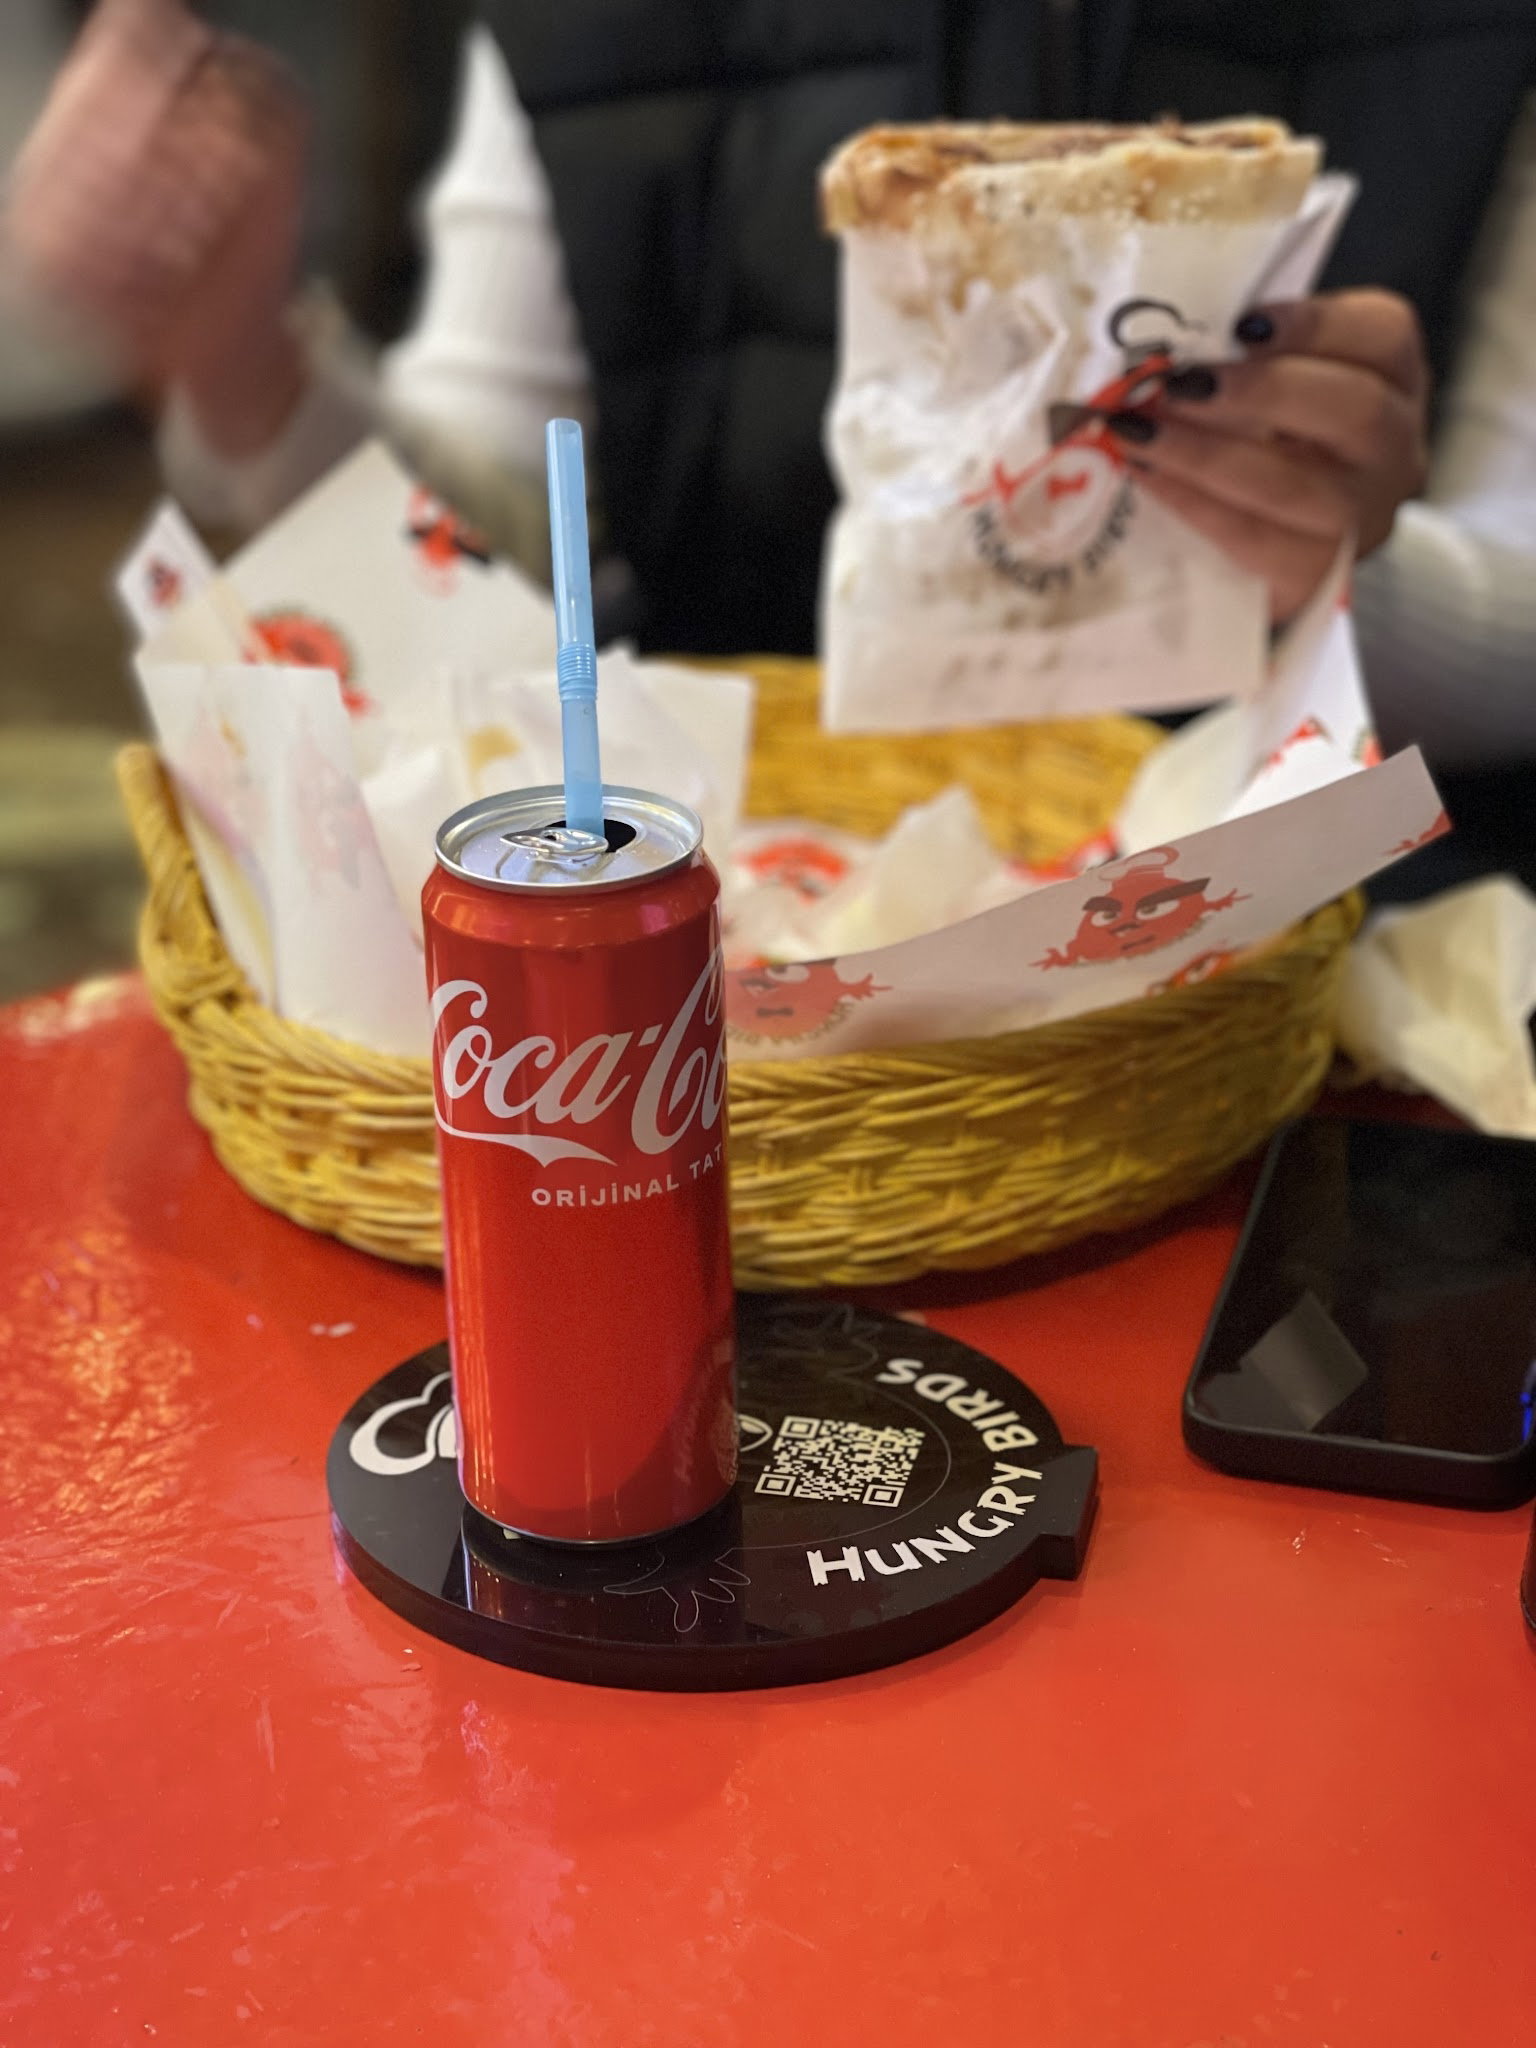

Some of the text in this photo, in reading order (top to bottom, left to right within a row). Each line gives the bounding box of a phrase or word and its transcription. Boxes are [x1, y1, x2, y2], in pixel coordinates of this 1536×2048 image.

[689, 1141, 722, 1180] TAT
[806, 1357, 1043, 1586] HUNGRY BIRDS
